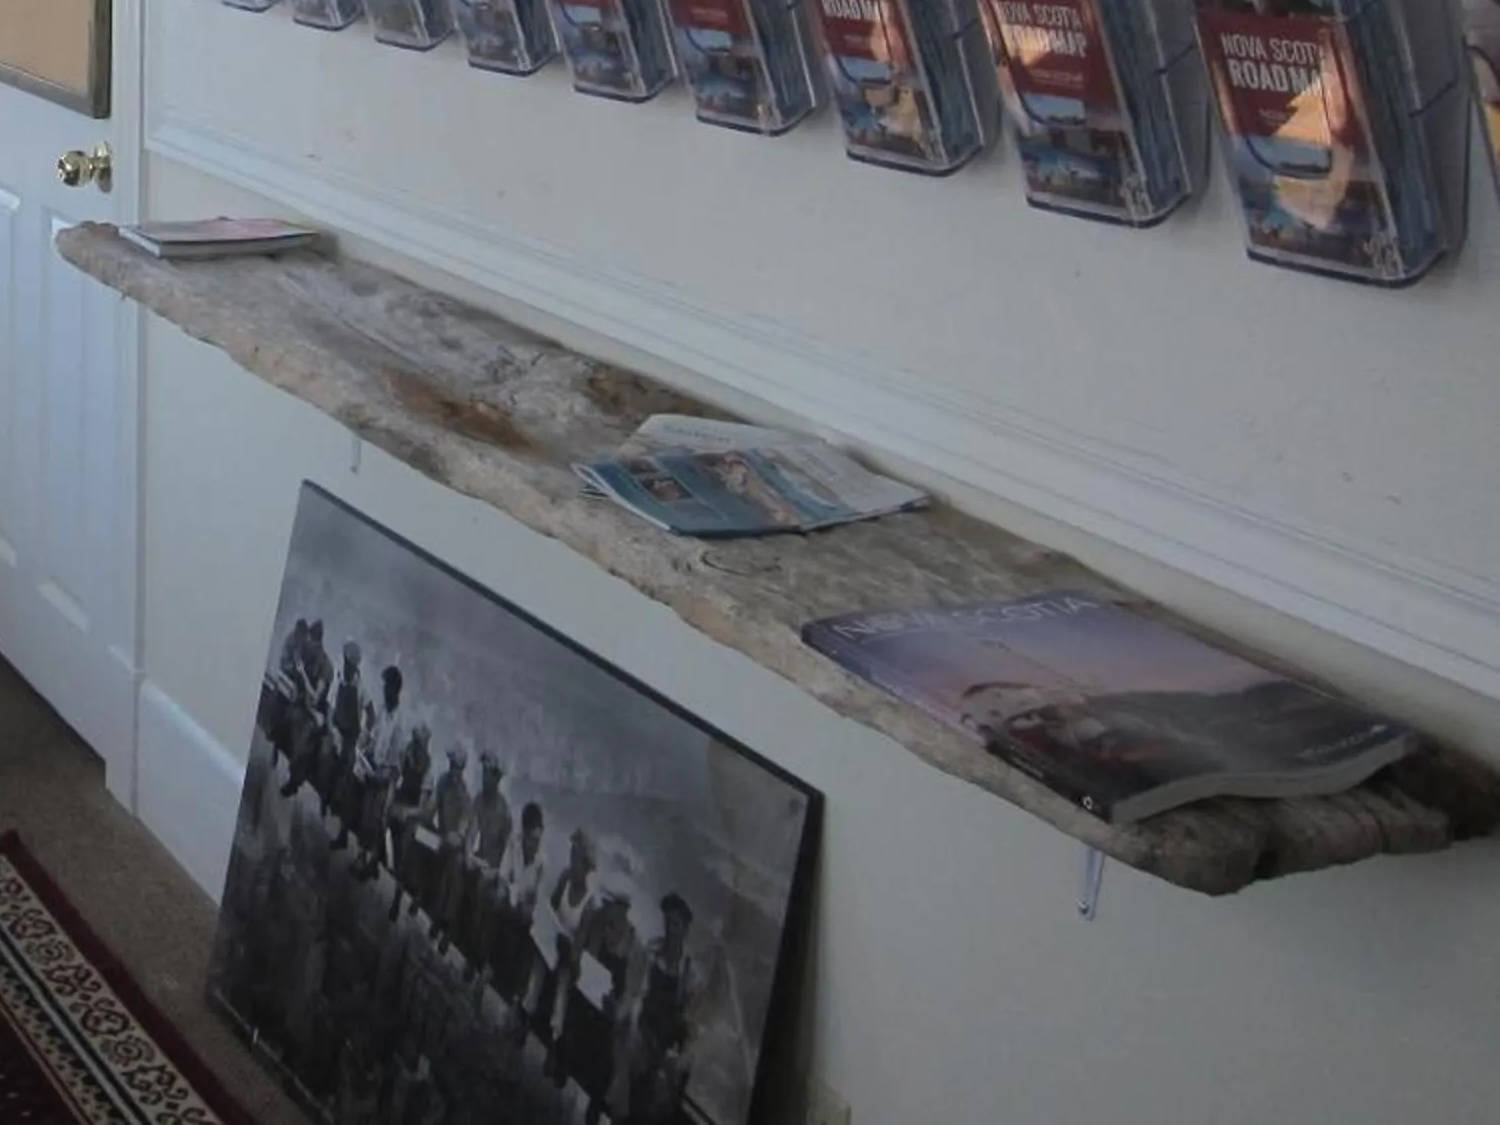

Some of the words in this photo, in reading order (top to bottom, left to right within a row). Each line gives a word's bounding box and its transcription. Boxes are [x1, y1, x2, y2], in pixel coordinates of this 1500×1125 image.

[1220, 31, 1268, 60] NOVA
[1227, 58, 1289, 93] ROAD
[1290, 67, 1324, 97] MA
